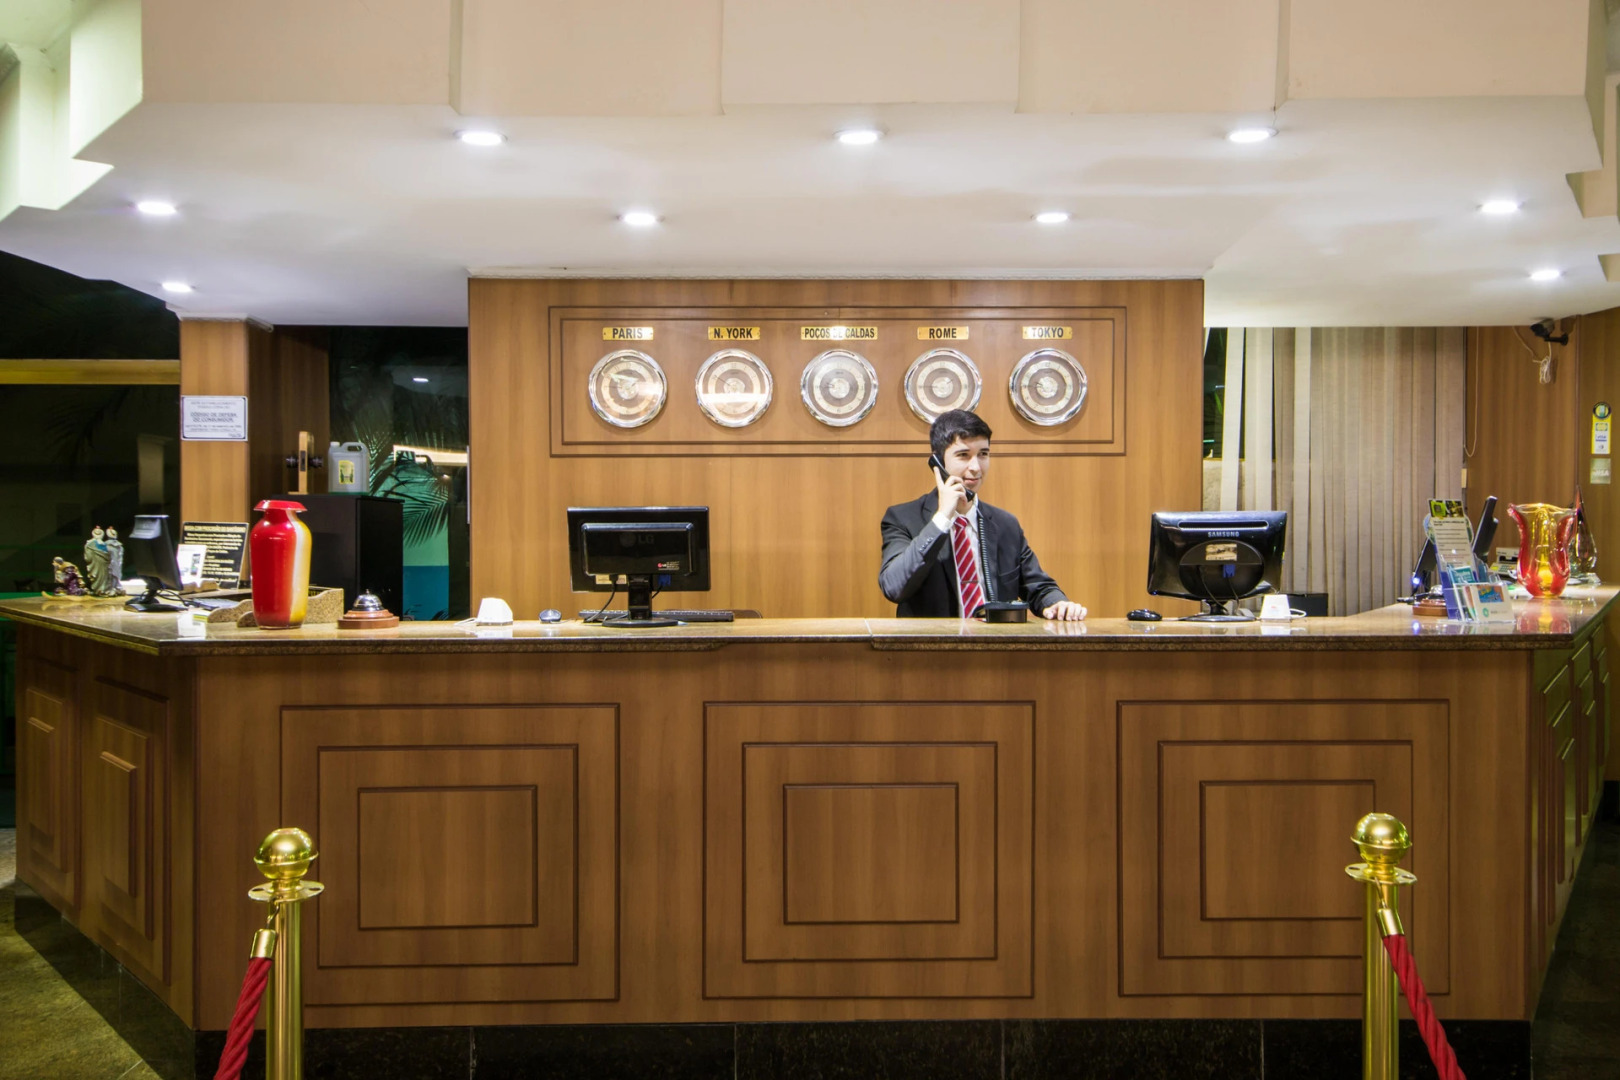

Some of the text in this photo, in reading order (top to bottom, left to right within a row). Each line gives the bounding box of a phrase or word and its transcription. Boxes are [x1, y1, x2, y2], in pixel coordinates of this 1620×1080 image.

[612, 328, 643, 339] PARIS
[713, 327, 753, 339] N. YORK
[804, 327, 831, 339] POÇOS
[845, 327, 875, 338] CALDAS
[928, 327, 957, 339] ROME
[1032, 327, 1064, 338] TOKYO
[638, 534, 655, 544] LG
